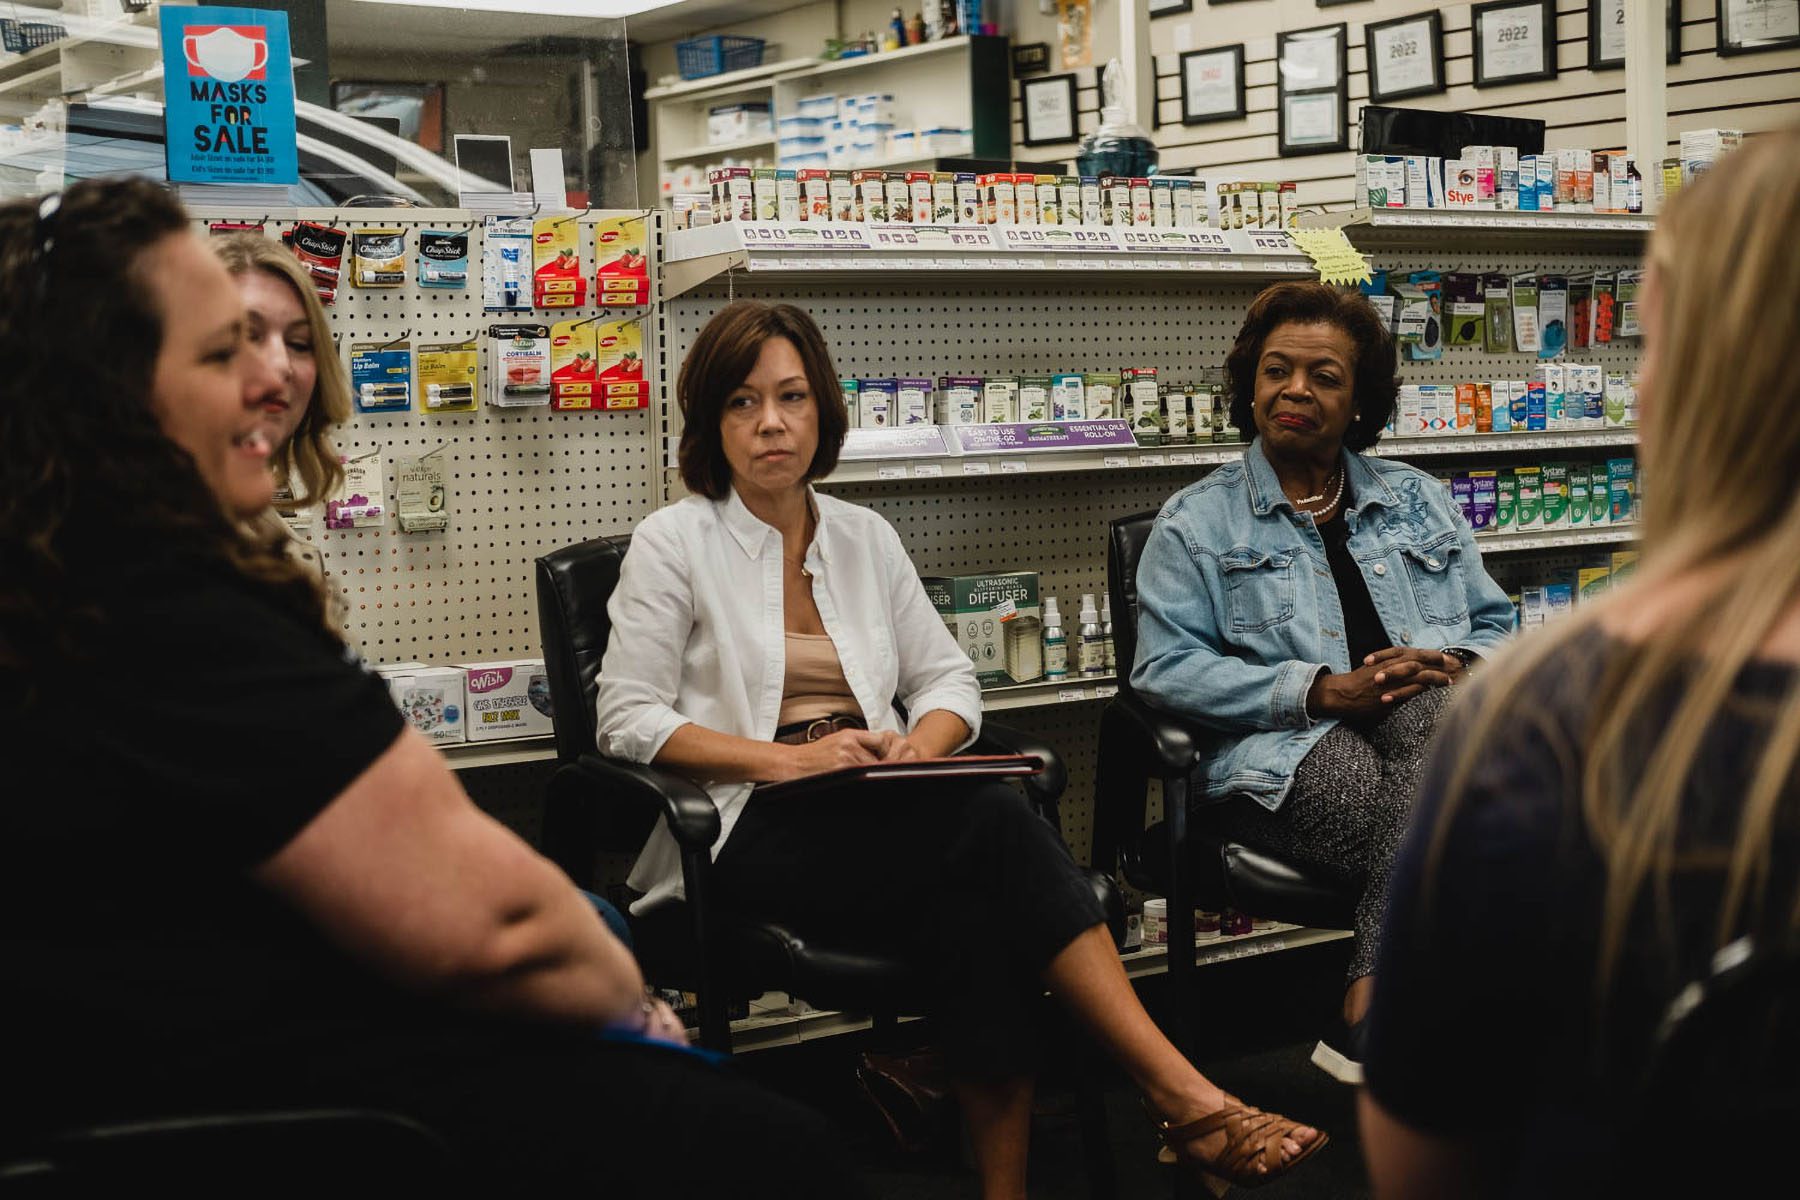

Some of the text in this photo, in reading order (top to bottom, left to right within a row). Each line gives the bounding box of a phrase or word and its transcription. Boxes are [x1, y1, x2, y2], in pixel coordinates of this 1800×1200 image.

[1497, 25, 1529, 43] 2022
[1389, 41, 1418, 59] 2022
[190, 81, 267, 104] MASKS
[211, 104, 252, 125] FOR
[194, 125, 269, 154] SALE
[1448, 190, 1474, 205] Stye
[301, 236, 337, 253] ChapStick
[360, 244, 398, 254] ChapStick
[425, 244, 462, 255] ChapStick
[1069, 424, 1107, 433] ESSENTIAL
[1108, 423, 1126, 431] OILS
[1084, 430, 1116, 438] ROLL-ON
[402, 472, 441, 482] naturals
[1542, 466, 1566, 481] Systane
[1610, 463, 1633, 478] Systane
[1519, 475, 1539, 488] Systane
[1571, 476, 1588, 486] Systane
[1592, 473, 1608, 484] Systane
[1453, 482, 1471, 492] Systane
[1473, 479, 1495, 492] Systane
[1498, 481, 1515, 491] Systane
[976, 577, 1019, 588] ULTRASONIC
[968, 588, 1028, 605] DIFFUSER
[470, 670, 504, 690] Wish
